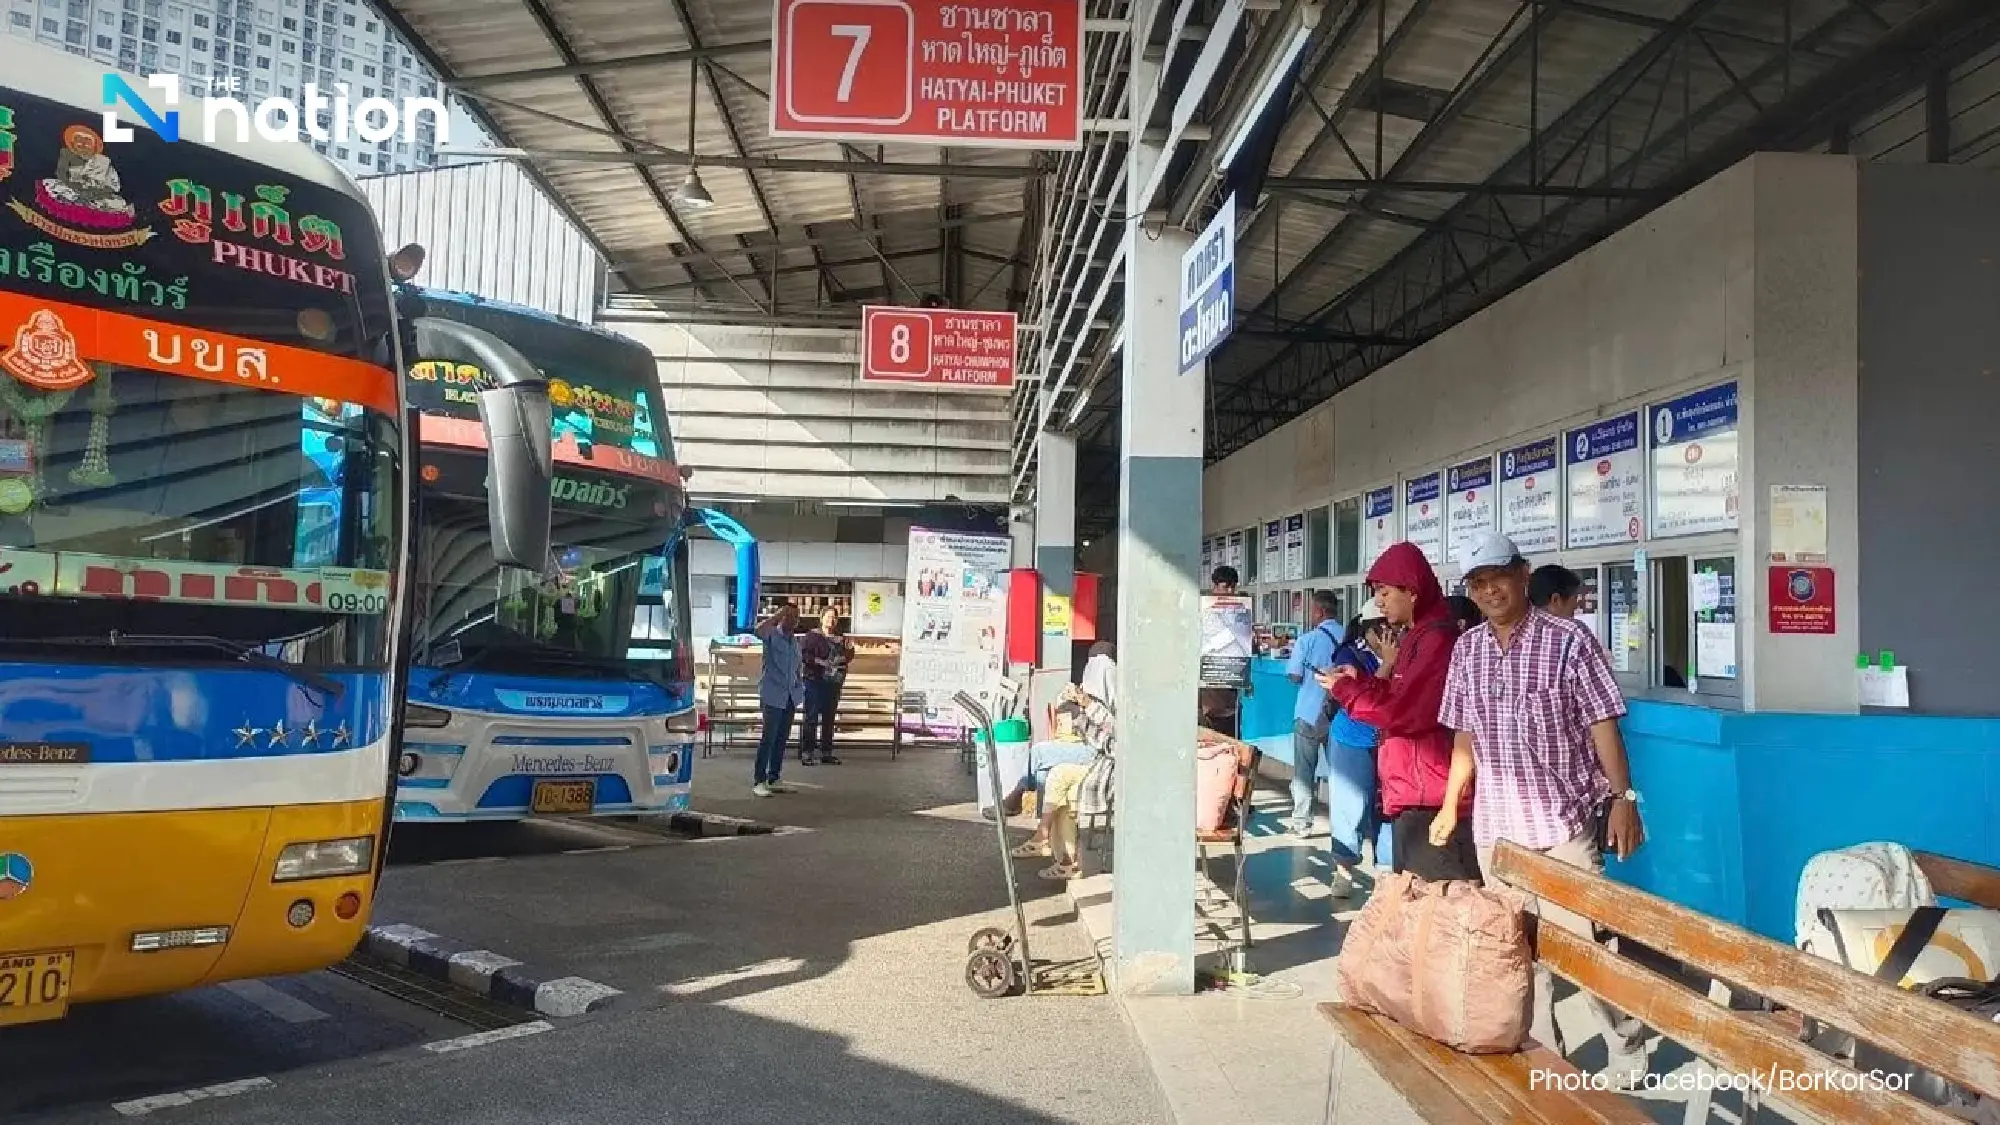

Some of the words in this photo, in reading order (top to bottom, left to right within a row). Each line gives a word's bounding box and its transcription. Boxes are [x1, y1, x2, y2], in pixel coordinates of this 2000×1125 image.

[940, 6, 1053, 34] ชานชาลา
[831, 24, 872, 103] 7
[922, 32, 1067, 78] หาดใหญ่-ภูเก็ต
[921, 78, 1067, 106] HATYAI-PHUKET
[937, 108, 1047, 133] PLATFORM
[158, 179, 346, 260] ภูเก็ต
[212, 239, 356, 295] PHUKET
[143, 327, 282, 383] บขส.
[890, 324, 910, 364] 8
[942, 368, 998, 383] PLATFORM
[328, 592, 387, 612] 09:00
[511, 753, 615, 772] Mercedes-Benz
